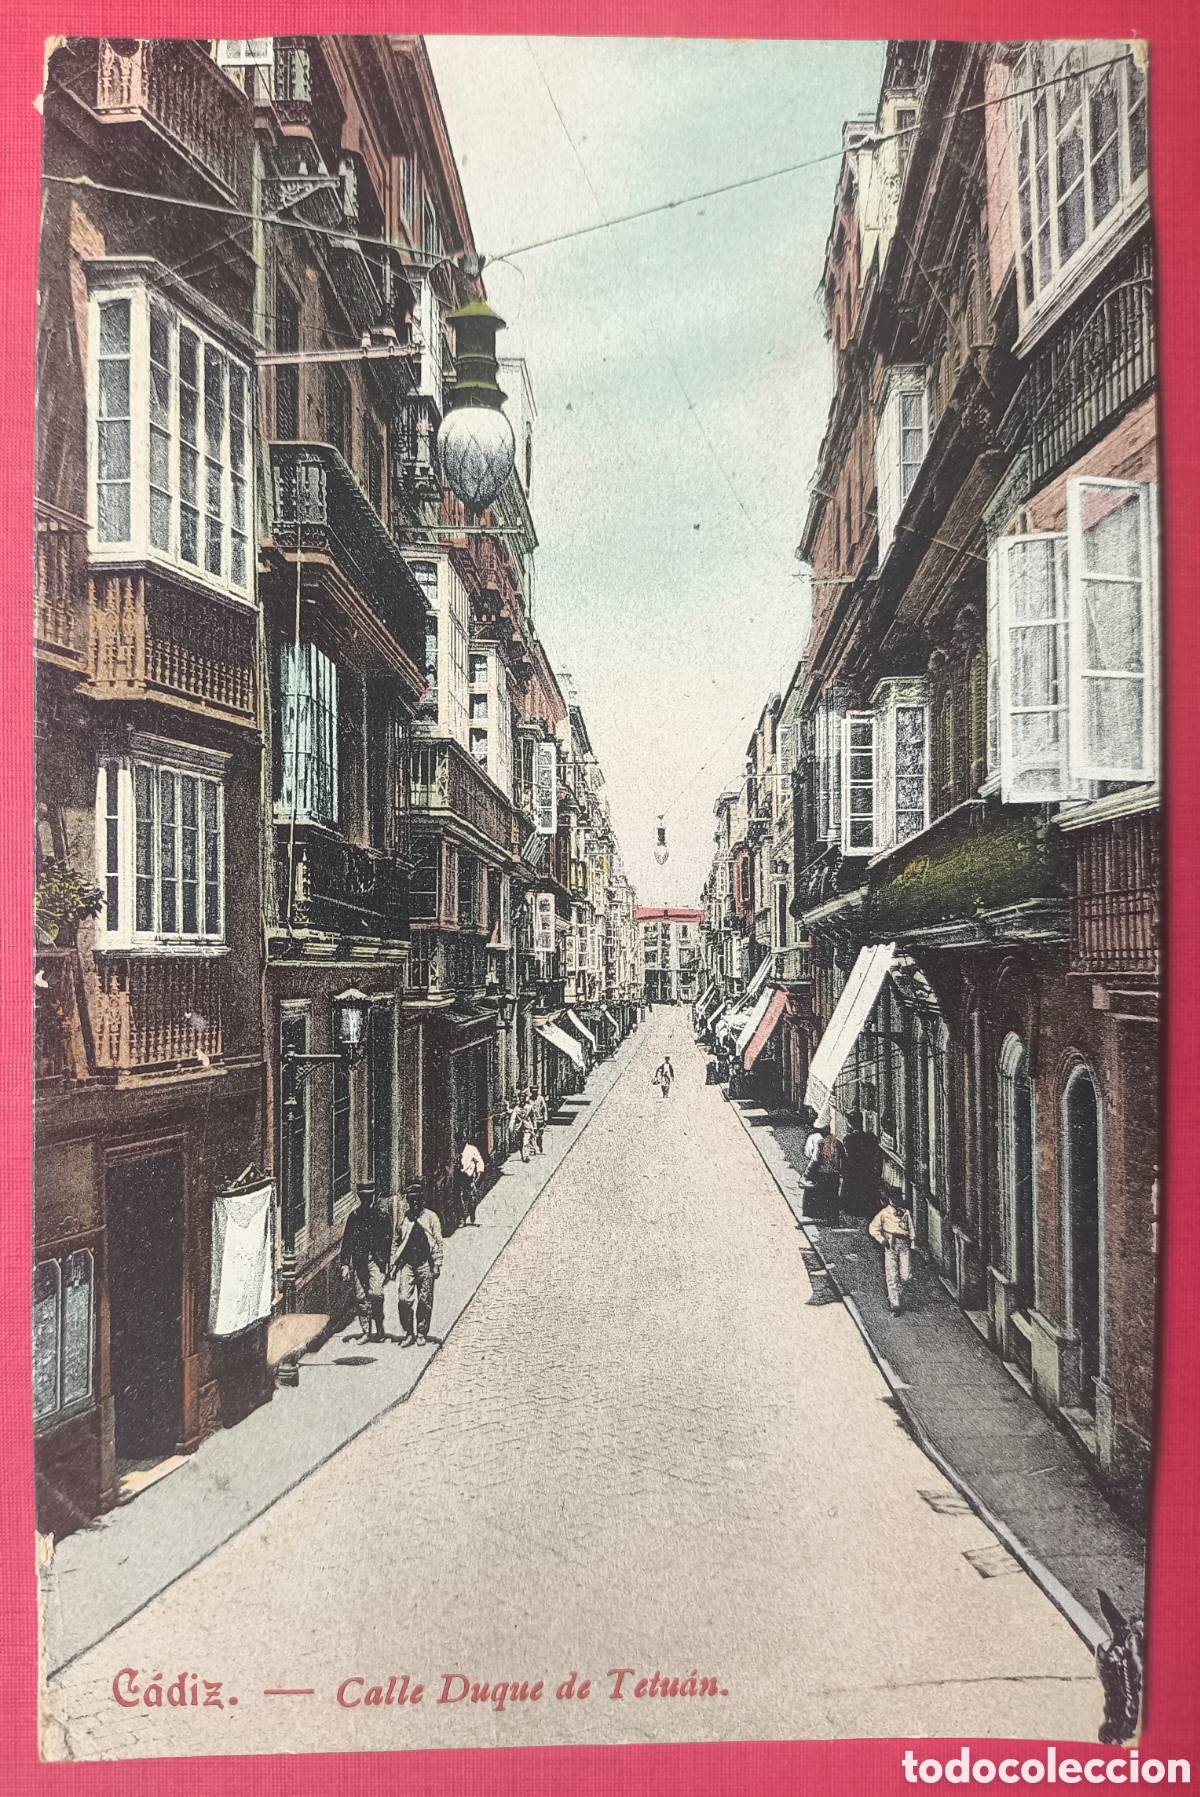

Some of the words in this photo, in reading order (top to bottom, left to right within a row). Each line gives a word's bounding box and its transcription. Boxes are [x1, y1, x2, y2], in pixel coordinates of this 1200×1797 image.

[112, 1668, 239, 1709] Cádiz.
[337, 1674, 425, 1708] Calle
[437, 1673, 544, 1711] Duque
[555, 1671, 591, 1700] de
[608, 1669, 729, 1699] Tetuán.
